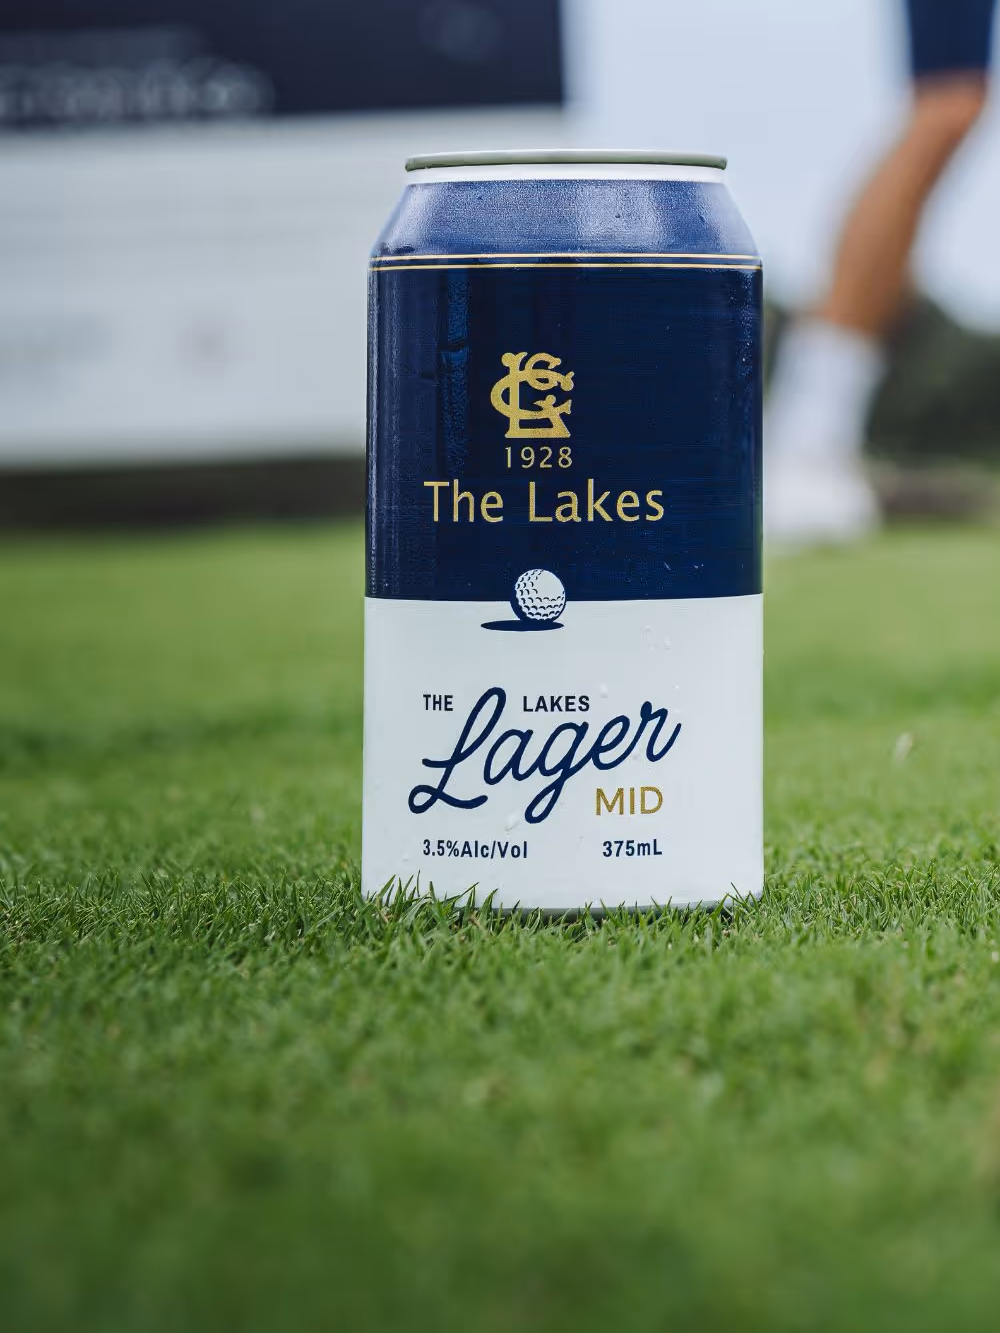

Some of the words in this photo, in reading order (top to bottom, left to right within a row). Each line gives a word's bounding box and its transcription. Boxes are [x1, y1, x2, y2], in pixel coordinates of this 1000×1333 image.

[504, 446, 574, 469] 1928
[424, 478, 504, 523] The
[529, 478, 665, 523] Lakes
[423, 694, 453, 712] THE
[522, 695, 590, 713] LAKES
[408, 686, 682, 824] Lager
[595, 786, 663, 816] MID
[602, 839, 663, 858] 375mL
